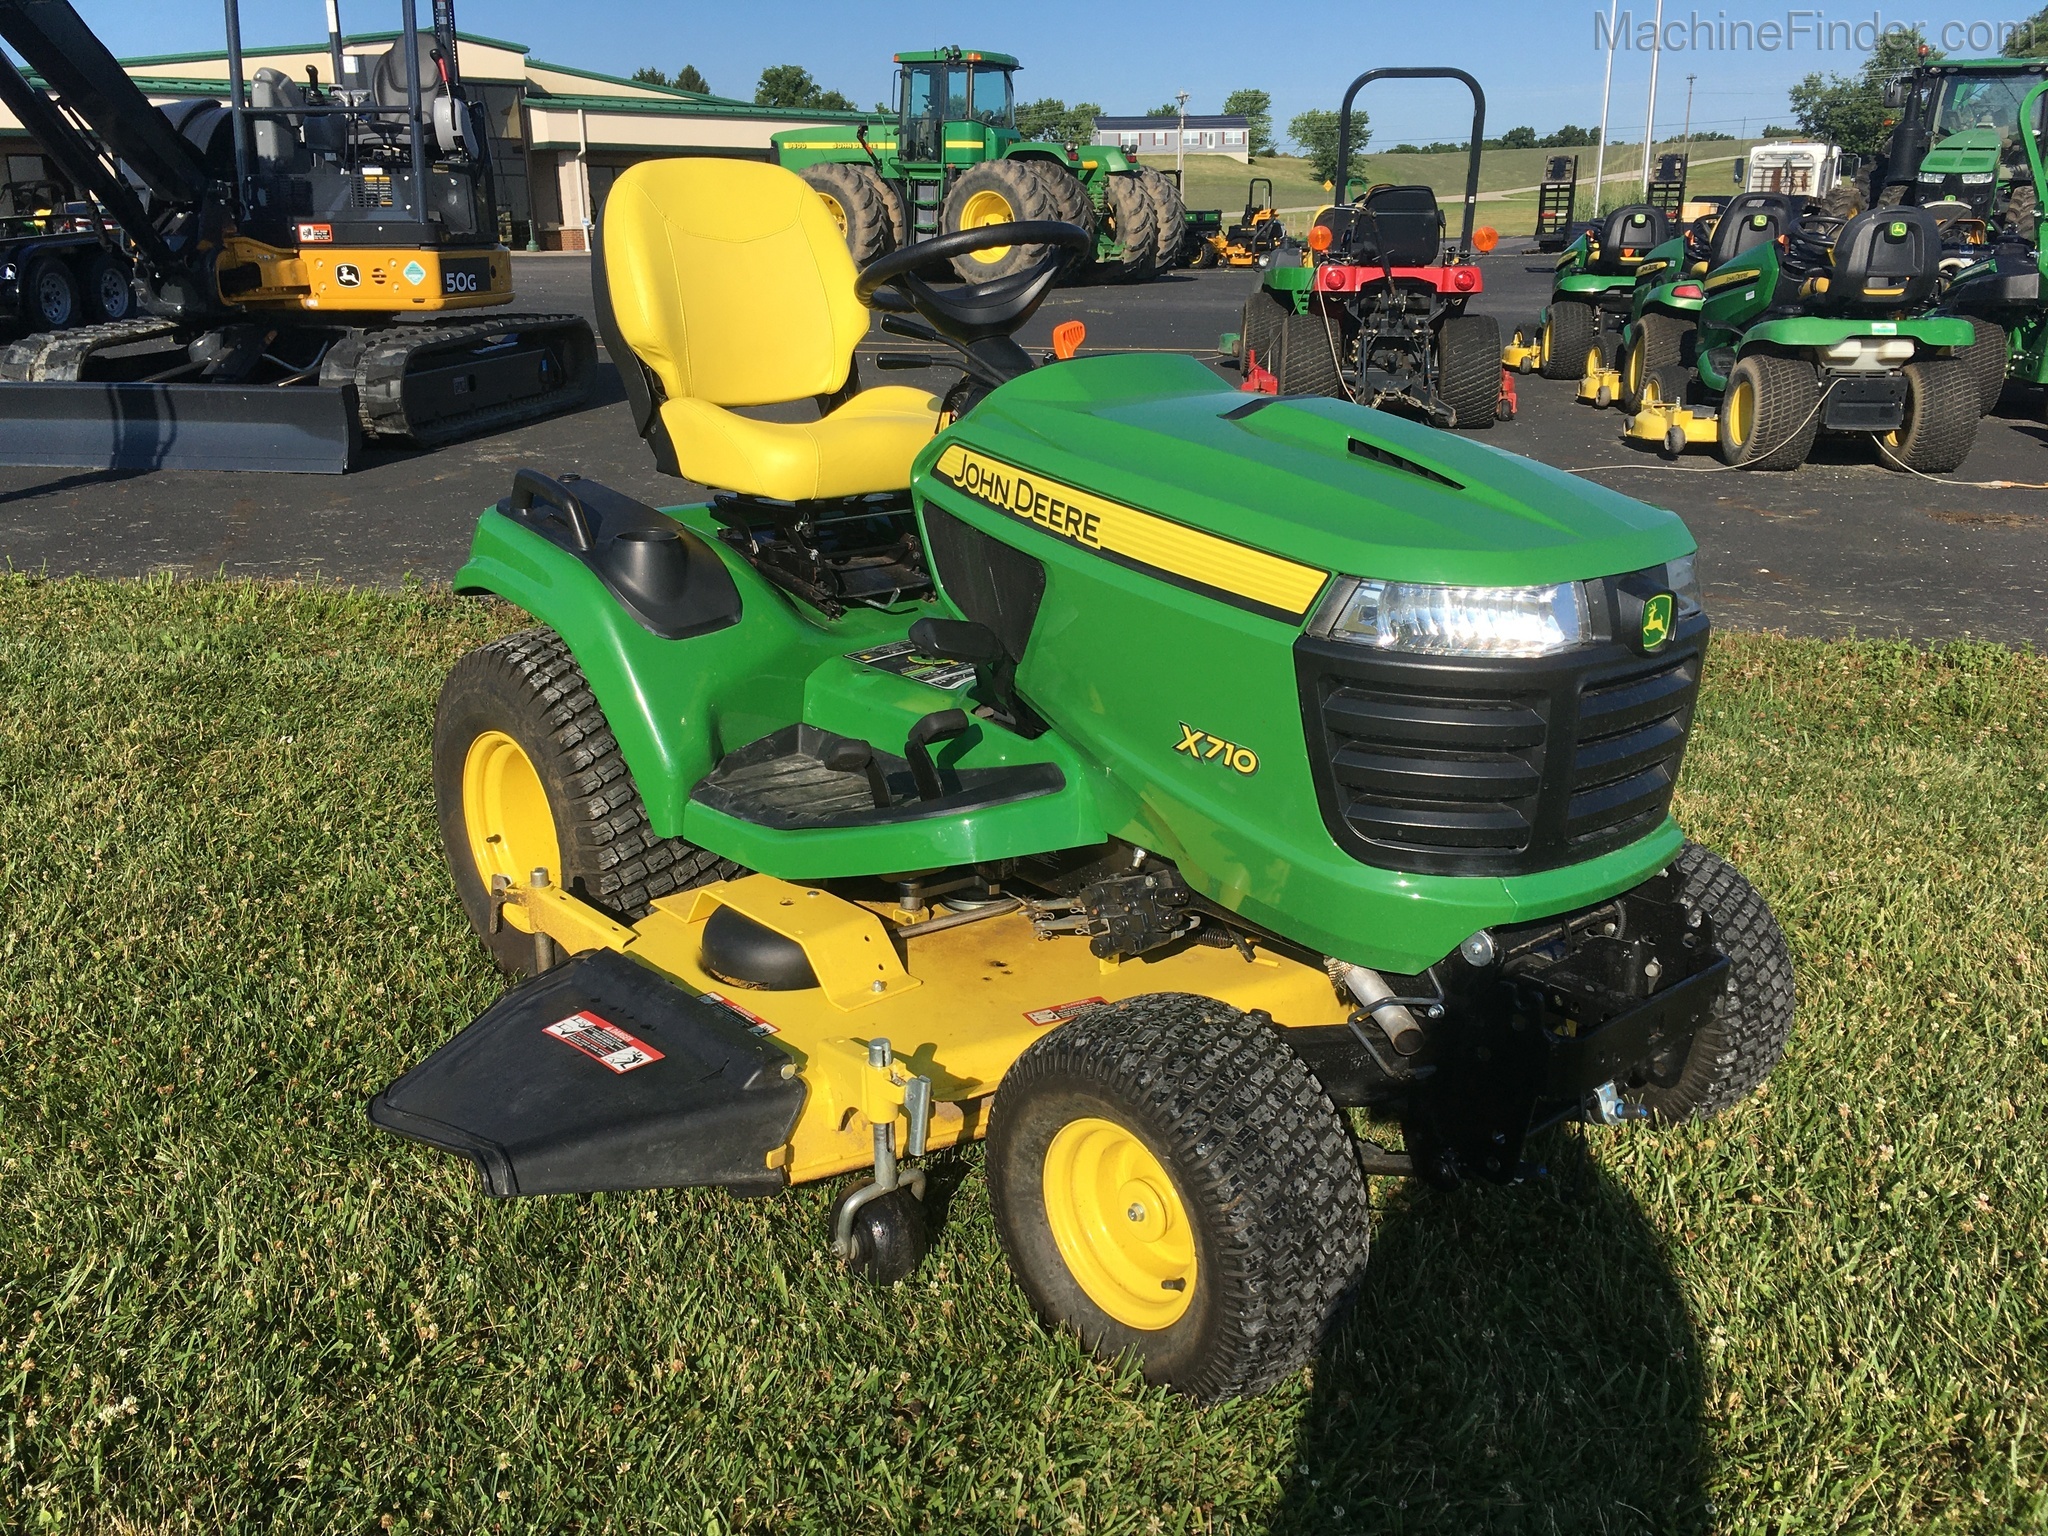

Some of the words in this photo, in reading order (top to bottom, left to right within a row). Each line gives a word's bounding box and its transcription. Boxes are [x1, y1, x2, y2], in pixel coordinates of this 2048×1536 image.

[446, 271, 477, 292] 50G
[954, 453, 1011, 505] JOHN
[1014, 477, 1101, 545] DEERE
[1172, 720, 1260, 775] X710
